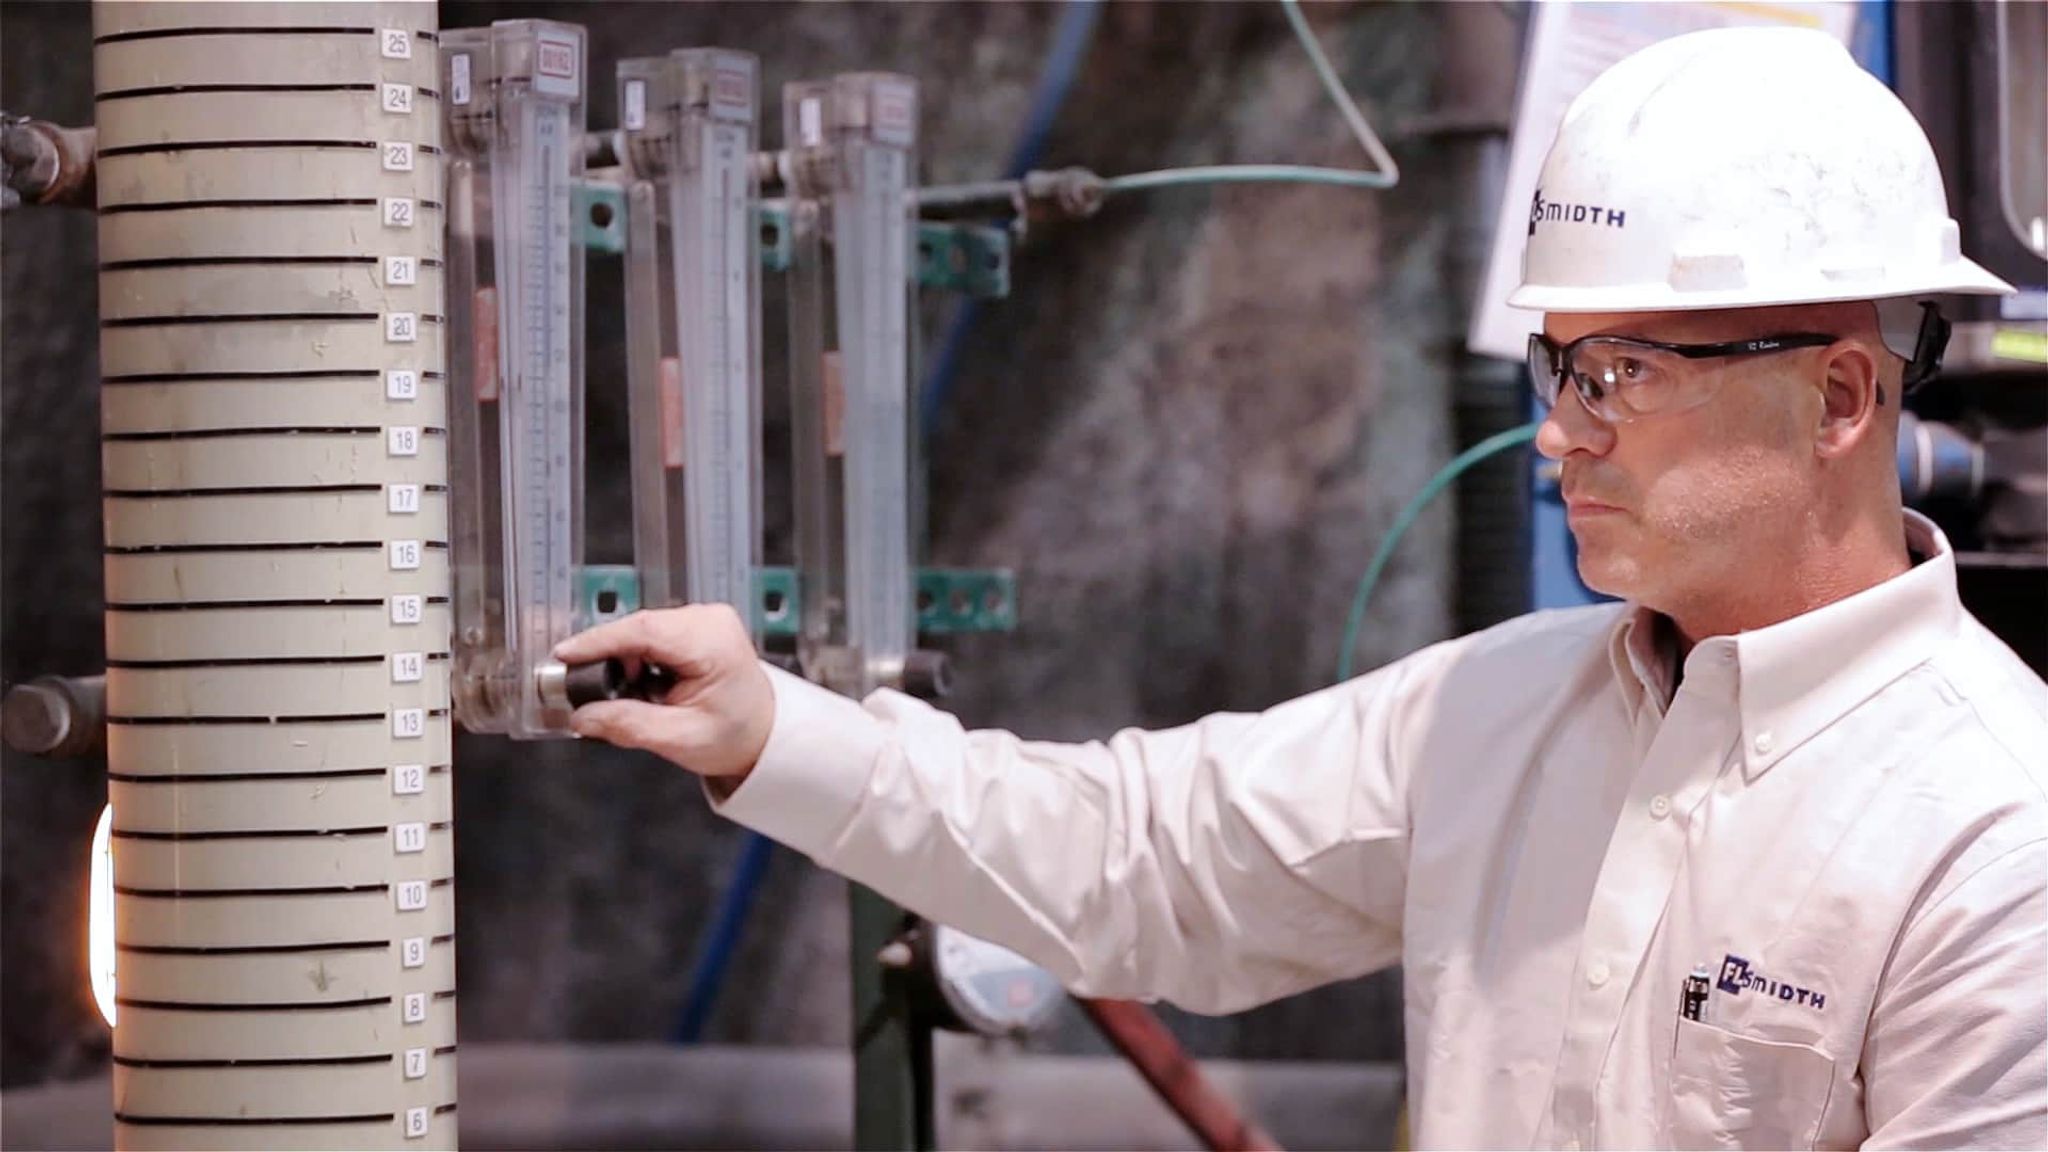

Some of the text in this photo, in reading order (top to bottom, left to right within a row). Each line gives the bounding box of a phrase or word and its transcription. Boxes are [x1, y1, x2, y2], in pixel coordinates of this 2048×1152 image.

[388, 33, 407, 54] 25
[389, 88, 408, 108] 24
[391, 146, 409, 166] 23
[391, 202, 409, 223] 22
[392, 260, 409, 281] 21
[393, 316, 411, 337] 20
[394, 375, 412, 394] 19
[396, 430, 414, 451] 18
[396, 488, 414, 508] 17
[398, 544, 415, 564] 16
[399, 598, 417, 619] 15
[400, 656, 418, 676] 14
[401, 712, 419, 733] 13
[402, 768, 419, 789] 12
[403, 827, 419, 847] 11
[405, 884, 422, 906] 10
[409, 942, 420, 962] 9
[409, 997, 420, 1017] 8
[411, 1052, 421, 1074] 7
[412, 1112, 423, 1132] 6
